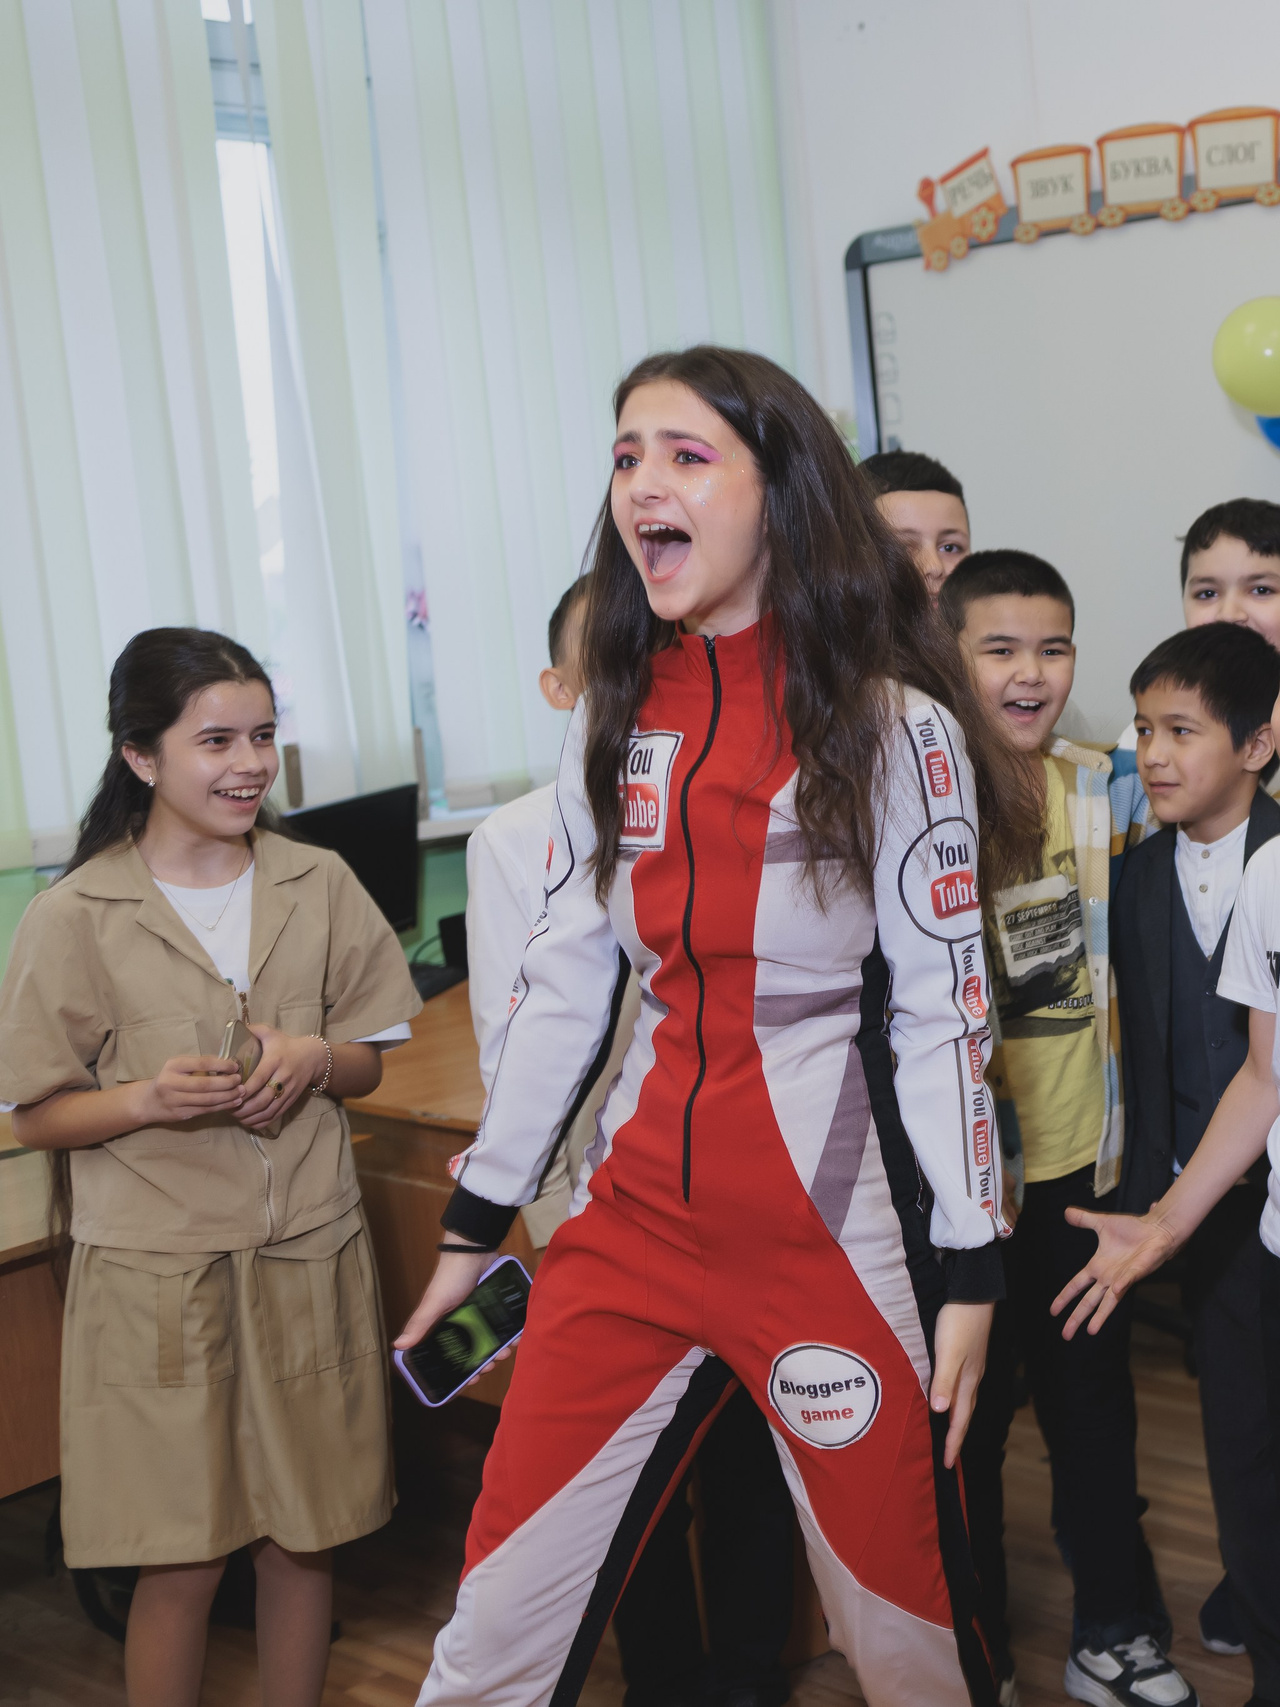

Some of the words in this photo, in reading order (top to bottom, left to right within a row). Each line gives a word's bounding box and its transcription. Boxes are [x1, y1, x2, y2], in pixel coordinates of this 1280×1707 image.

[1206, 140, 1261, 167] СЛОГ
[1109, 155, 1173, 181] БУКВА
[1029, 173, 1074, 198] ЗВУК
[915, 717, 938, 749] You
[929, 753, 947, 795] Tube
[933, 840, 970, 870] You
[934, 877, 979, 912] Tube
[1006, 913, 1015, 925] 27
[1045, 924, 1057, 933] PLAY
[961, 942, 976, 976] You
[965, 978, 983, 1016] Tube
[976, 1122, 988, 1164] Tube
[978, 1166, 991, 1198] You
[779, 1376, 866, 1399] Bloggers
[801, 1407, 854, 1424] game
